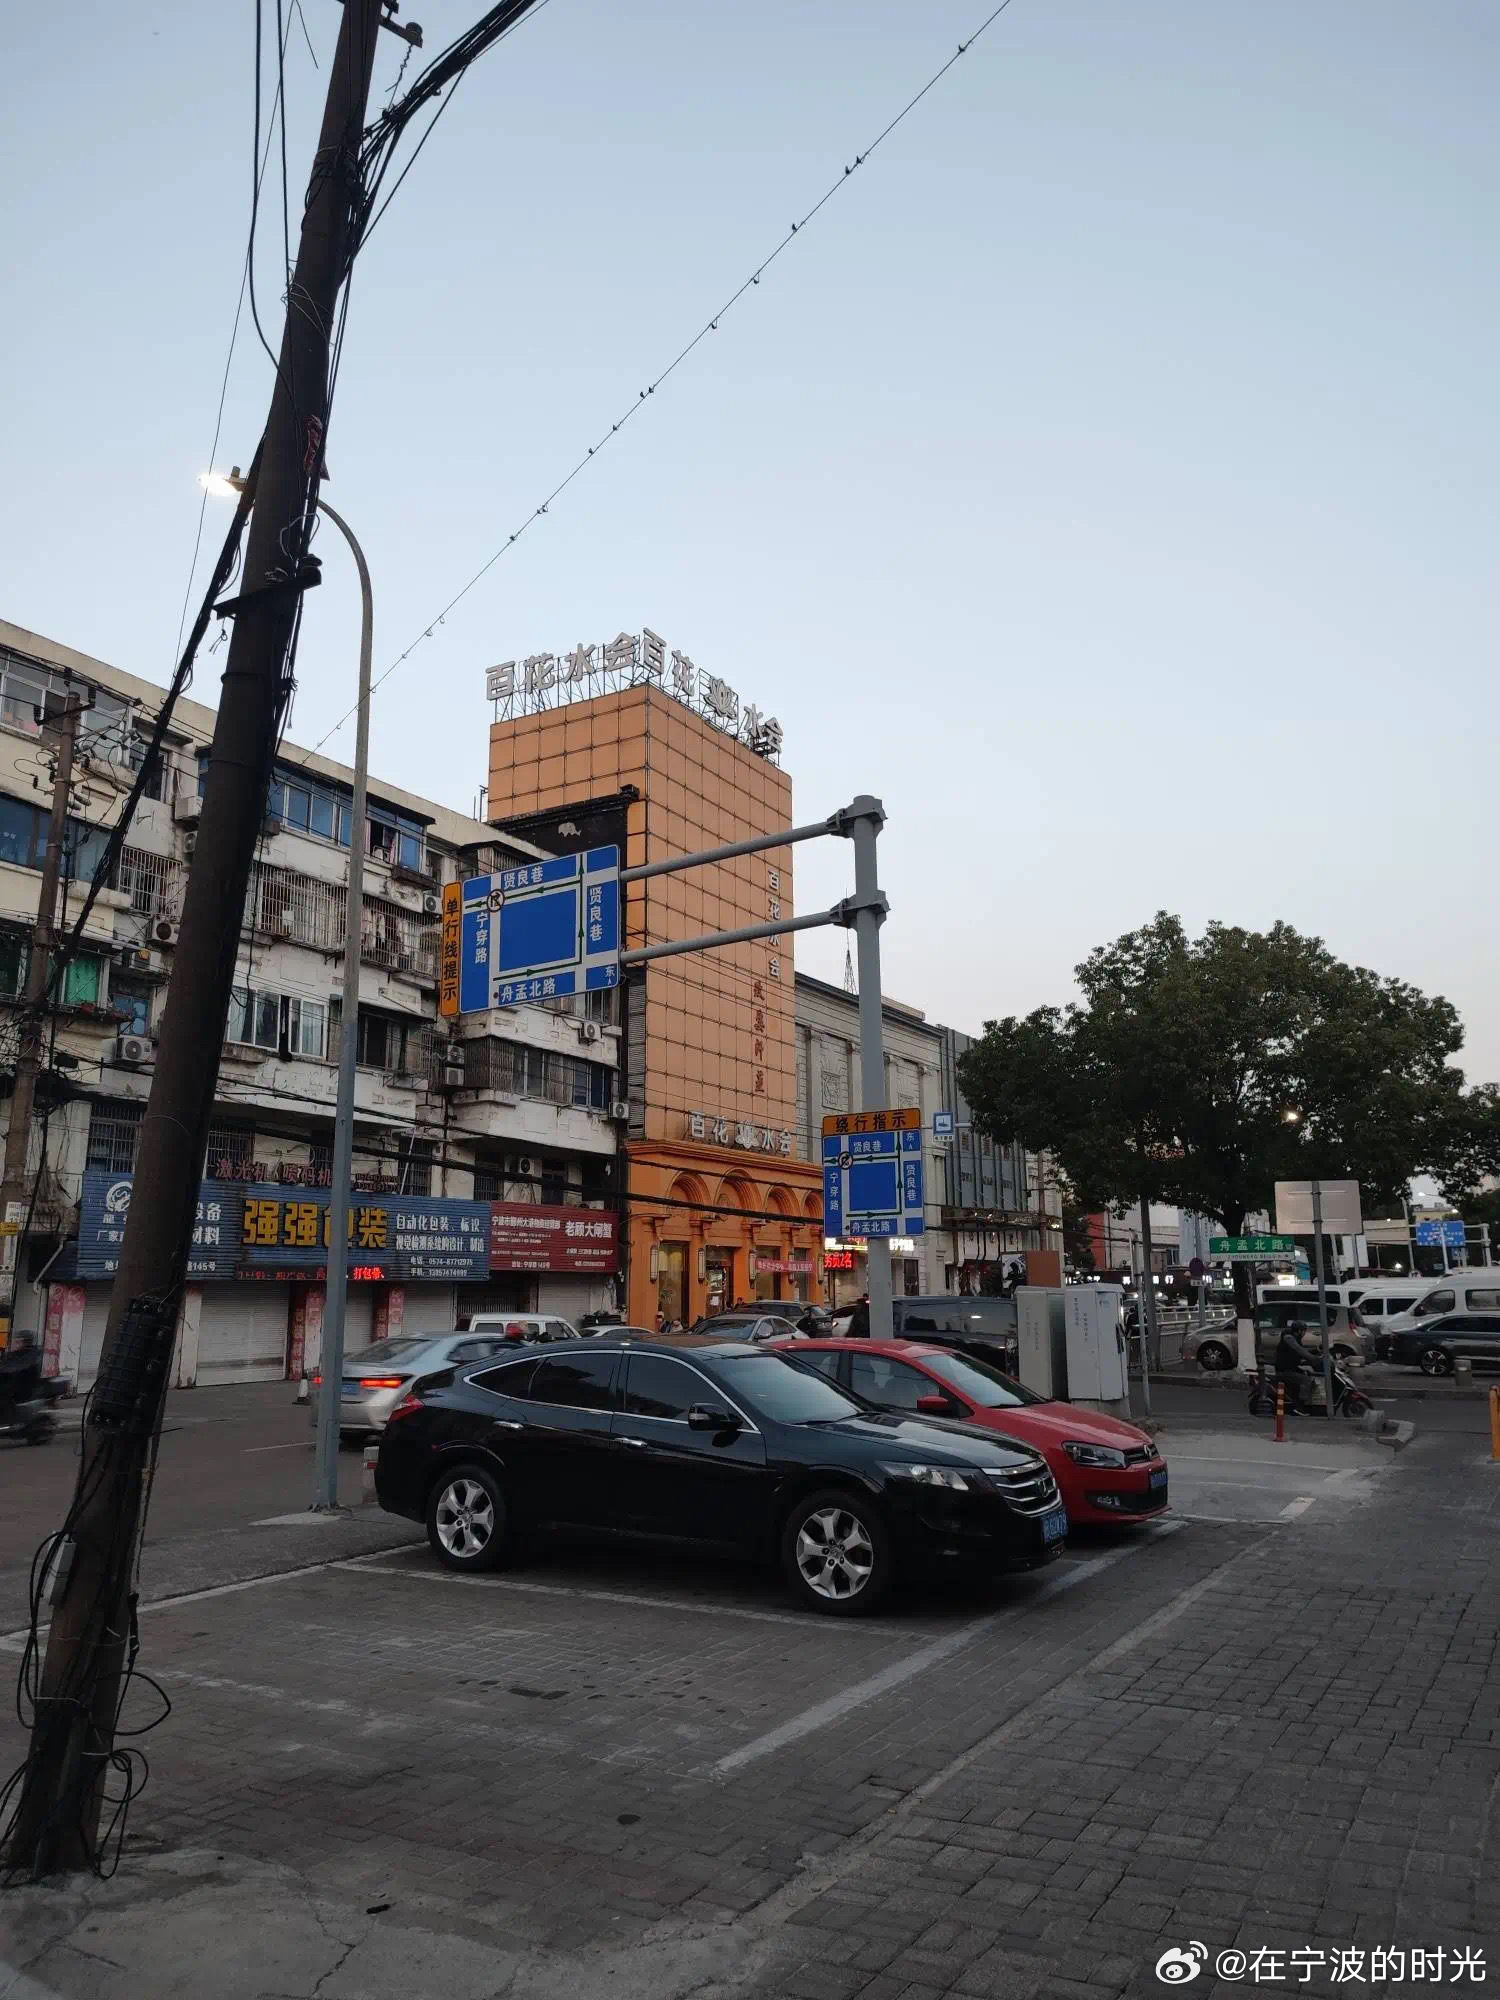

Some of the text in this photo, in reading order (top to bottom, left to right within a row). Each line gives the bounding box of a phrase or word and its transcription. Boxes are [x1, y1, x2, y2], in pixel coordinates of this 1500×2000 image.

[485, 631, 640, 701] 百花水会
[503, 866, 544, 889] 贤良巷
[588, 886, 603, 942] 贤良巷
[475, 912, 489, 964] 宁穿路
[443, 899, 460, 1001] 单行线提示
[605, 966, 616, 977] 东
[501, 977, 556, 1003] 舟孟北路
[835, 1112, 906, 1133] 绕行指示
[853, 1140, 882, 1153] 贤良巷
[906, 1132, 915, 1141] 东
[829, 1172, 839, 1211] 宁穿路
[906, 1164, 916, 1201] 贤良巷
[565, 1220, 613, 1239] 老顾大闸蟹
[852, 1221, 890, 1233] 舟孟北路
[1219, 1239, 1284, 1251] 舟孟北路
